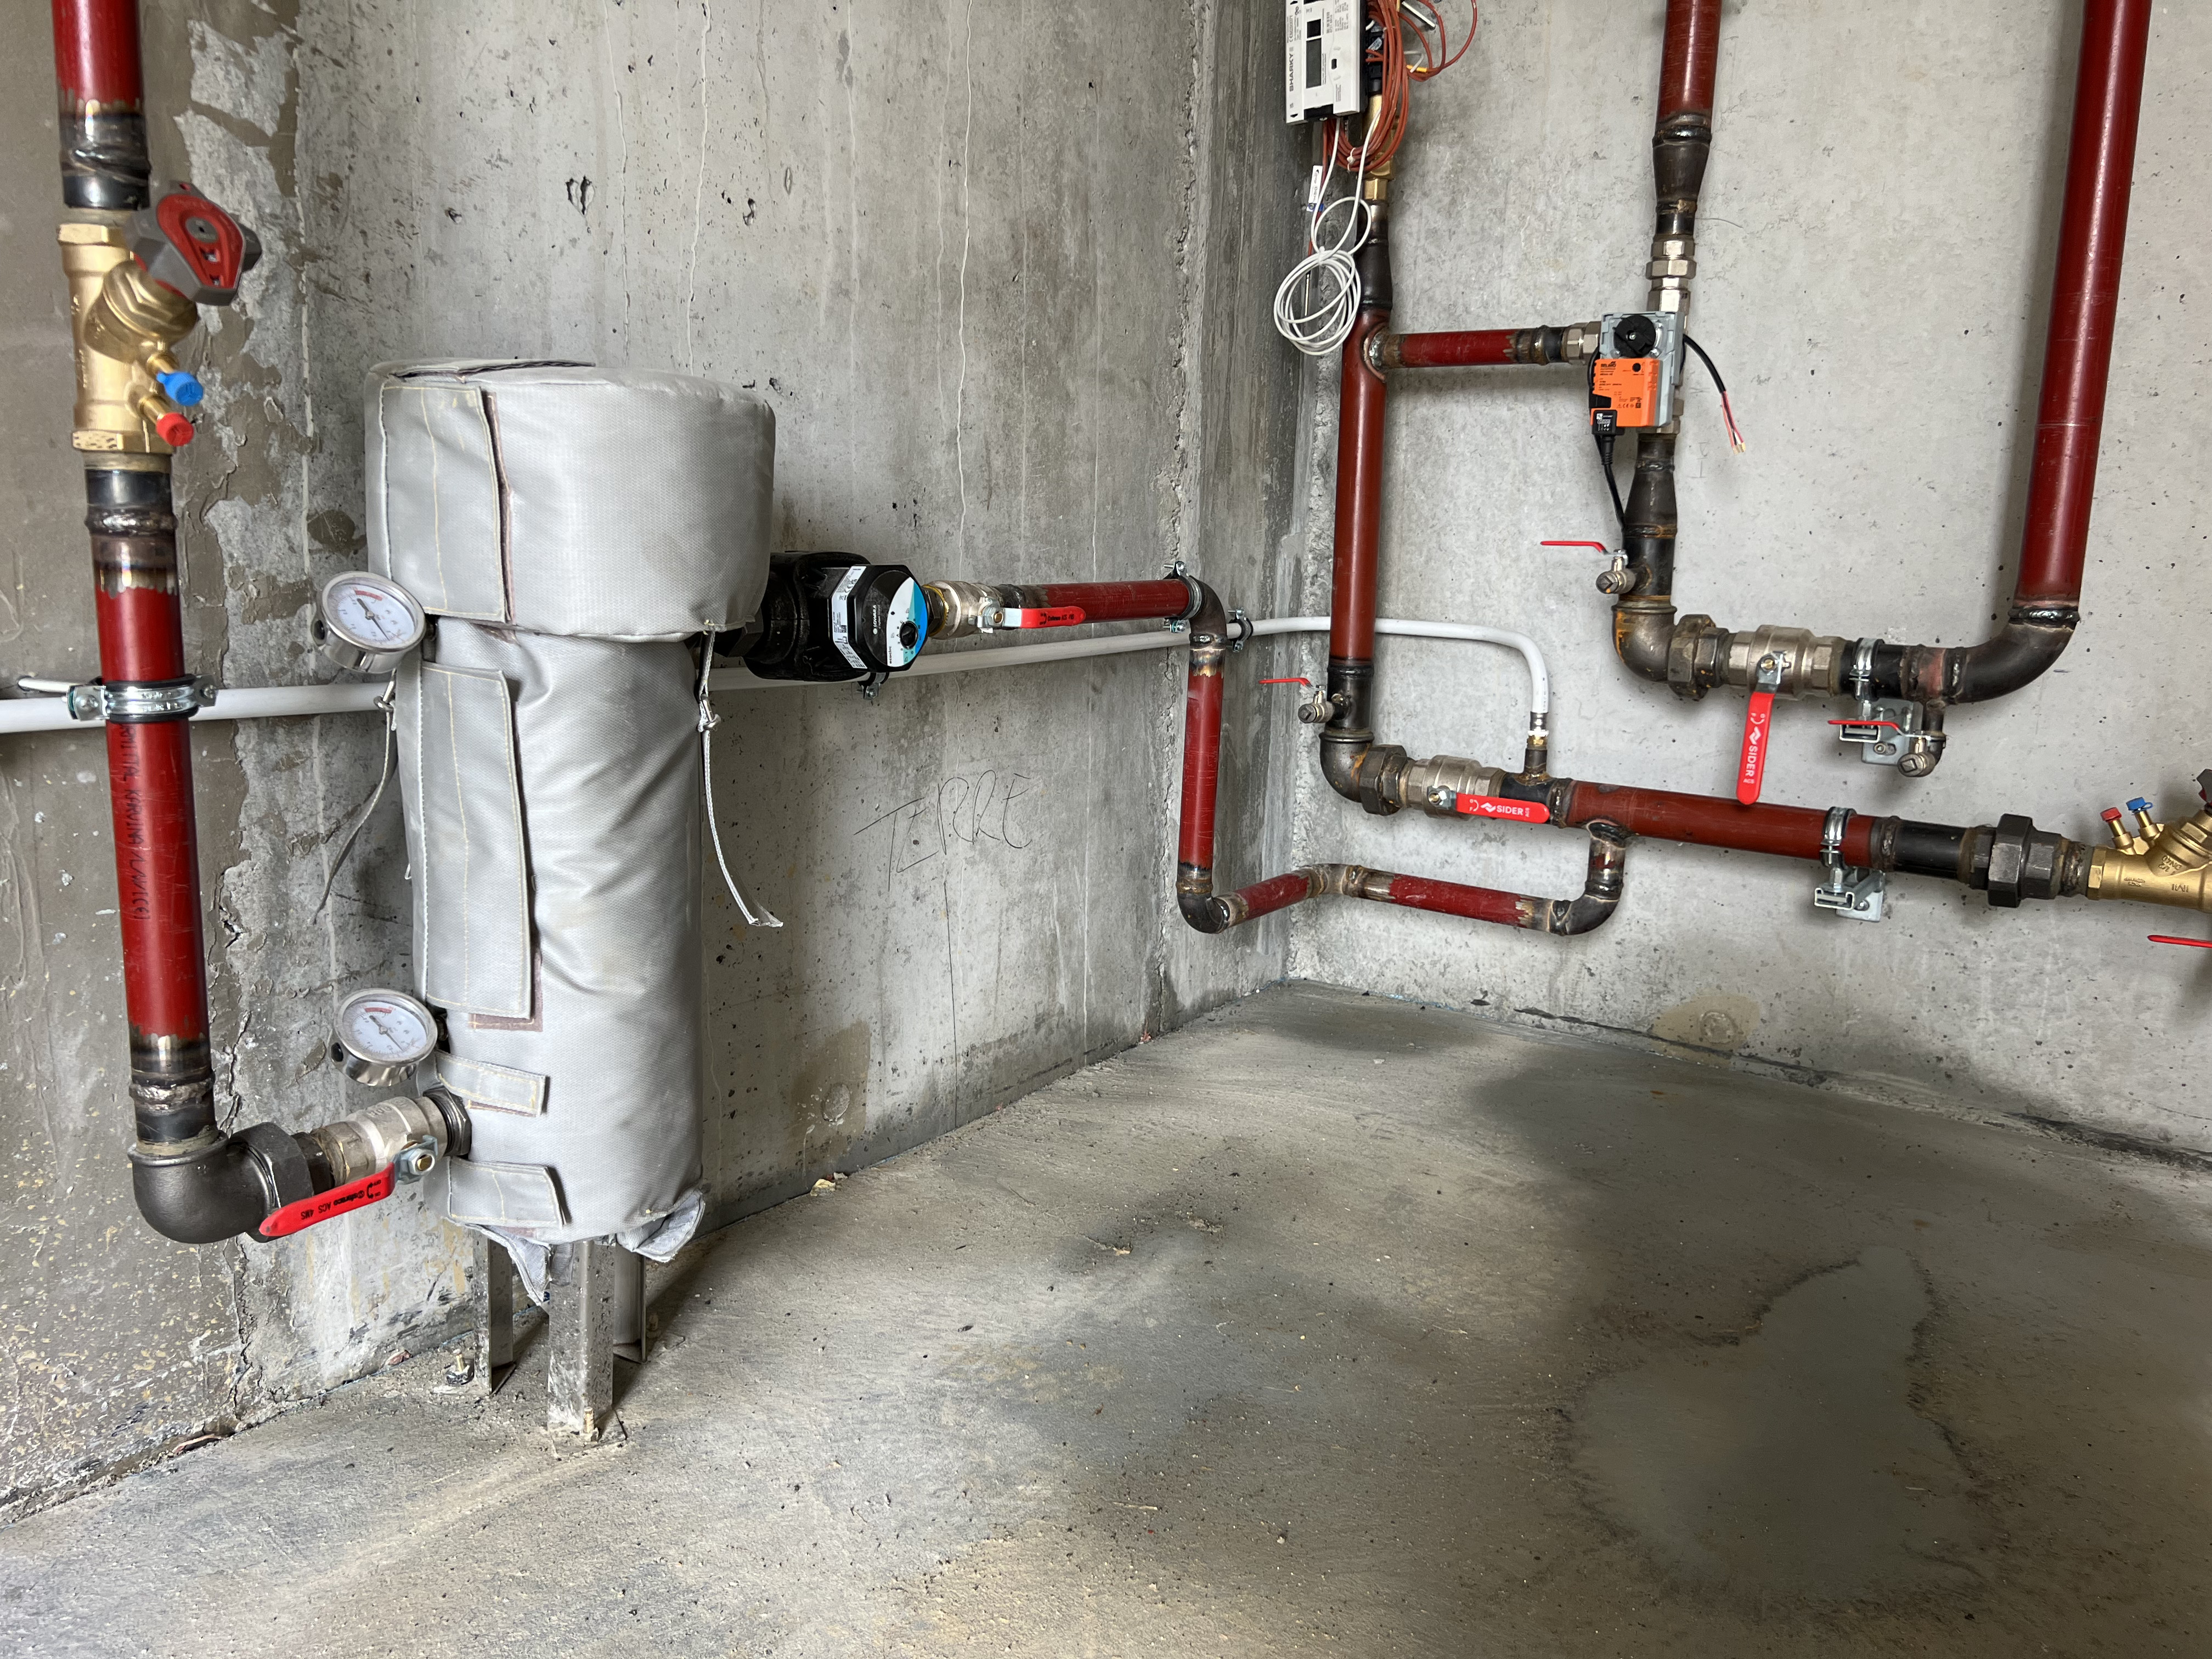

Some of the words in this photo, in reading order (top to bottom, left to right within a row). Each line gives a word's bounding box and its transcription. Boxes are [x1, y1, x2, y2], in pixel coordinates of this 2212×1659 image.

[1745, 745, 1758, 777] SIDER
[1496, 805, 1523, 816] SIDER
[2171, 883, 2189, 893] IMI
[318, 1202, 331, 1214] ACS
[300, 1209, 314, 1221] 4MS
